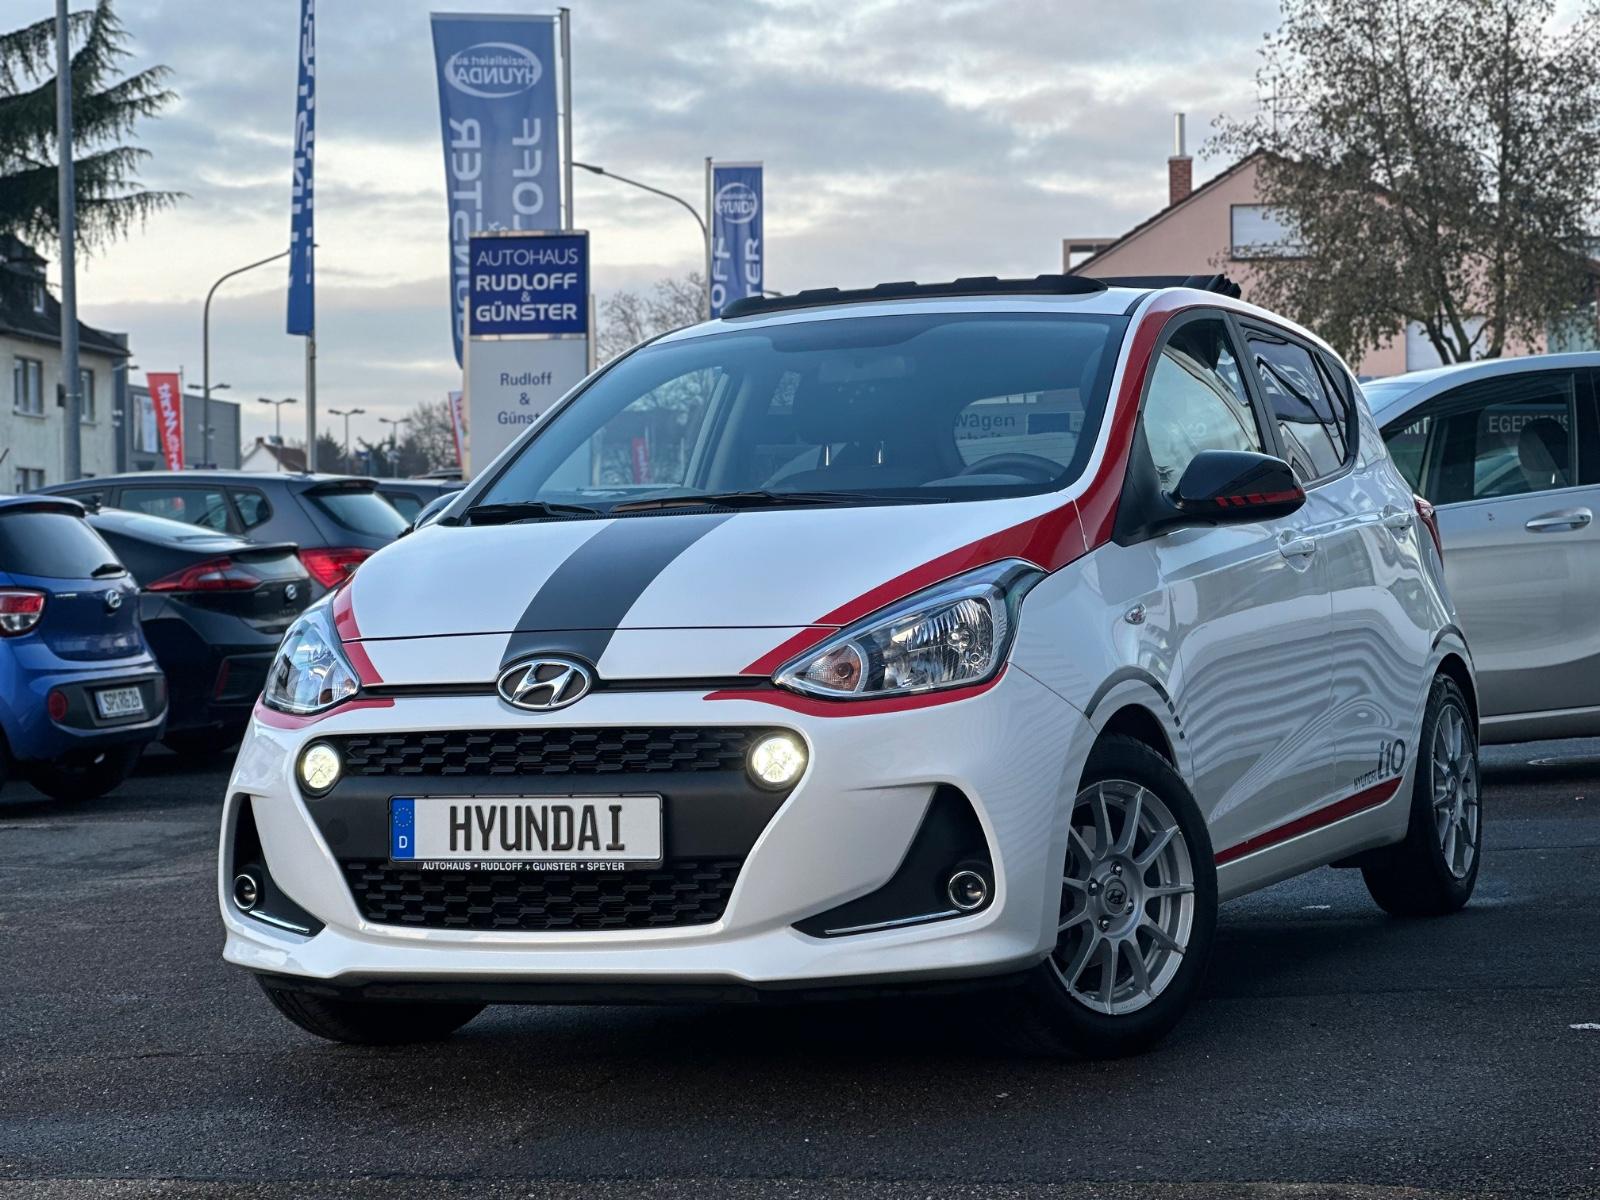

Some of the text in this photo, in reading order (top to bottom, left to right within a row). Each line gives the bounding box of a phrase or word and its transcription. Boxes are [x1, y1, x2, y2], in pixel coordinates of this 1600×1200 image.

[476, 248, 579, 266] AUTOHAUS
[475, 273, 578, 291] RUDLOFF
[521, 291, 531, 303] &
[475, 300, 578, 321] GÜNSTER
[499, 372, 552, 386] Rudloff
[519, 392, 530, 405] &
[1377, 738, 1406, 779] i10
[449, 804, 625, 852] HYUNDAI
[398, 835, 408, 849] D
[421, 862, 471, 871] AUTOHAUS
[480, 862, 523, 871] RUDLOFF
[587, 862, 625, 871] SPEYER
